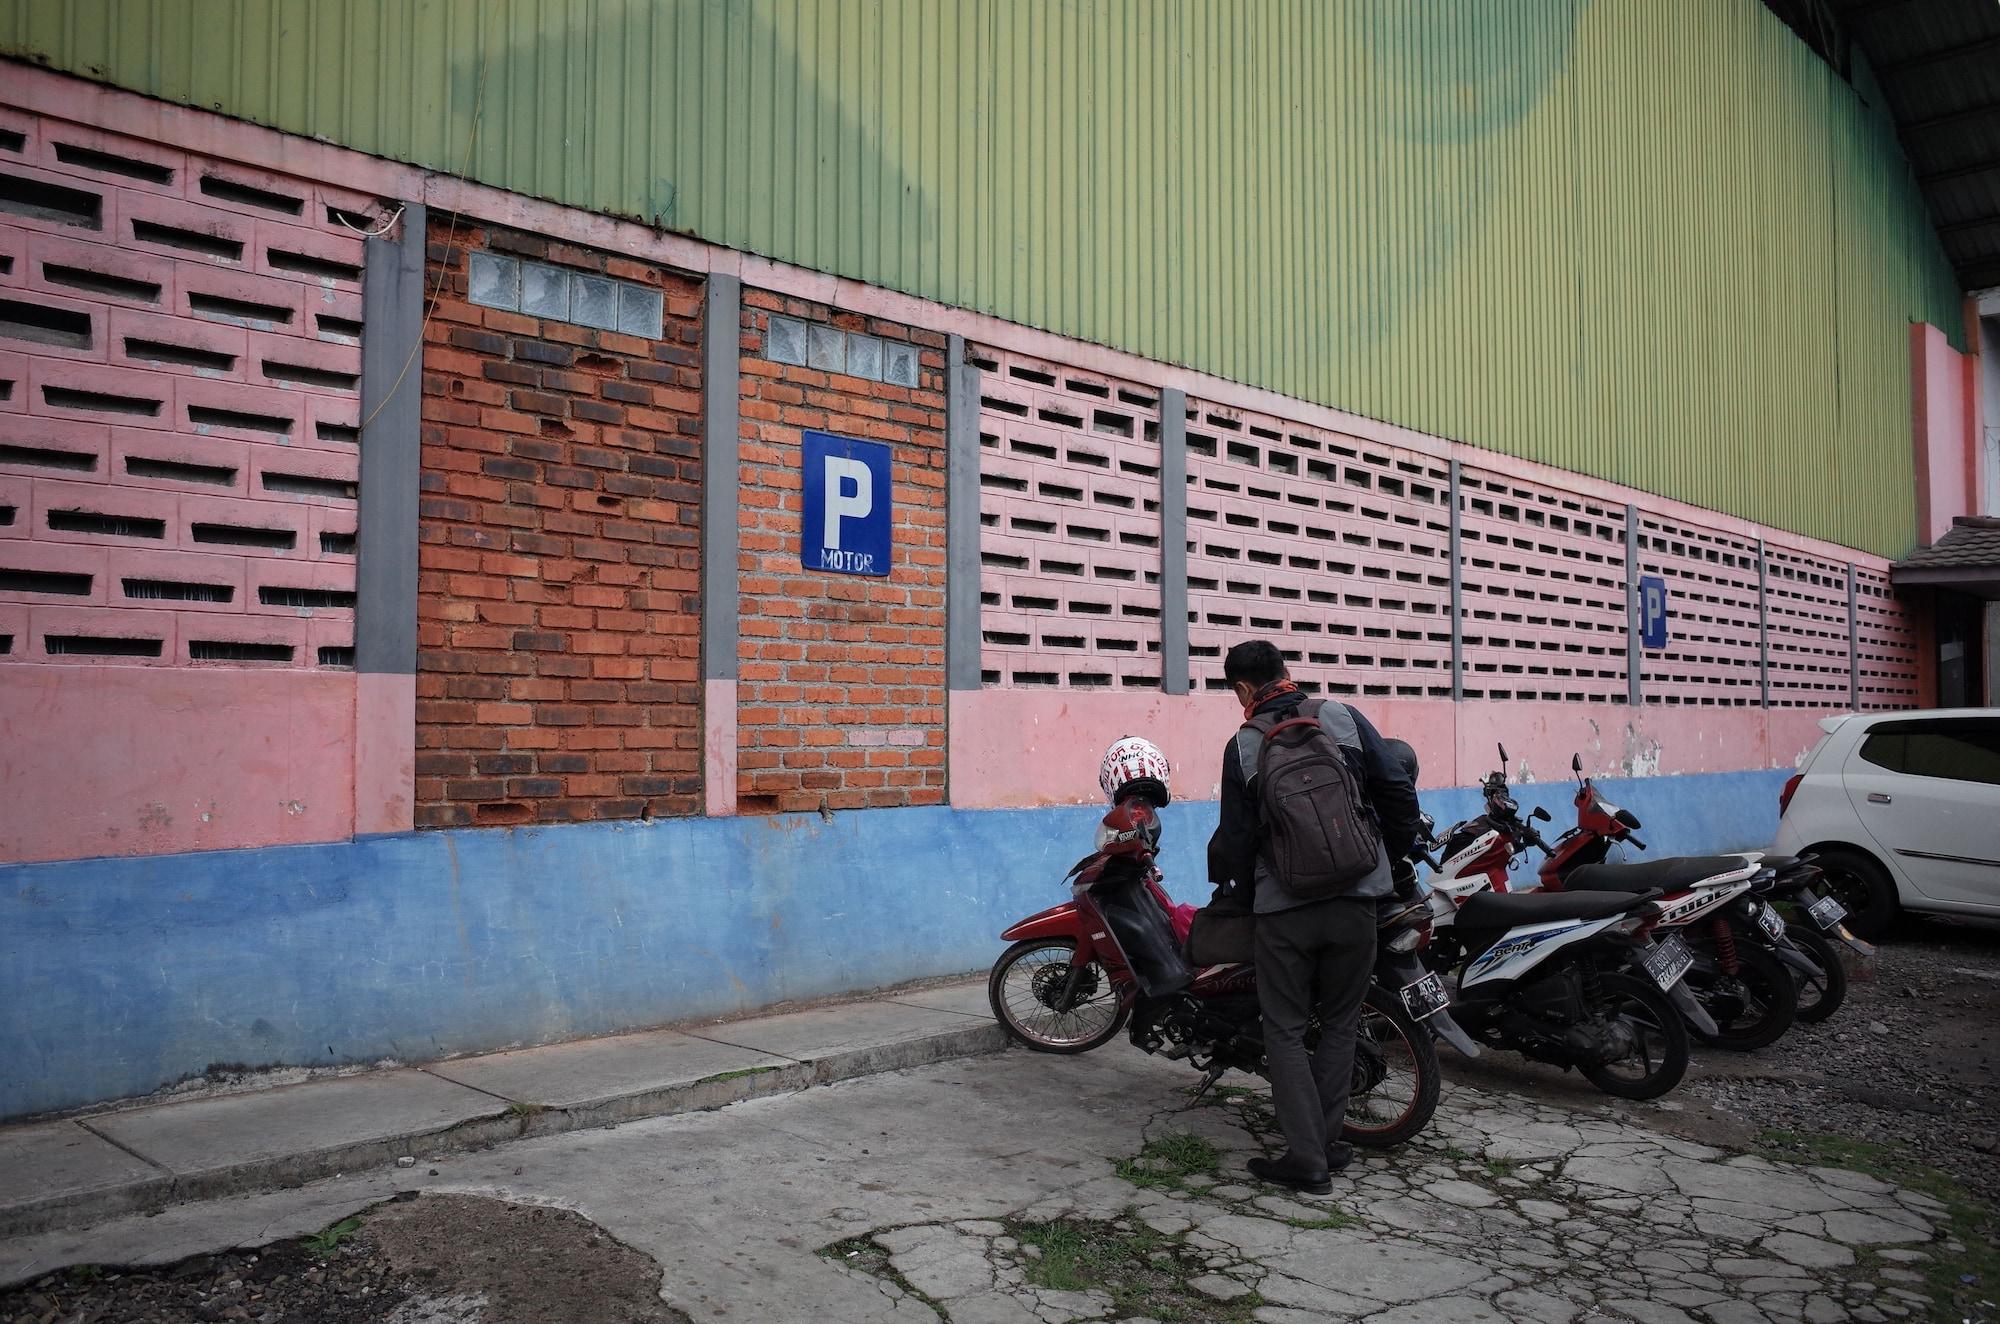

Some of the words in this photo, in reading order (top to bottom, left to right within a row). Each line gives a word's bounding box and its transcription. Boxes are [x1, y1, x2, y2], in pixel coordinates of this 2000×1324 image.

[824, 455, 873, 549] P
[820, 548, 874, 572] MOTOR
[1646, 587, 1661, 637] P
[1403, 990, 1411, 1005] F
